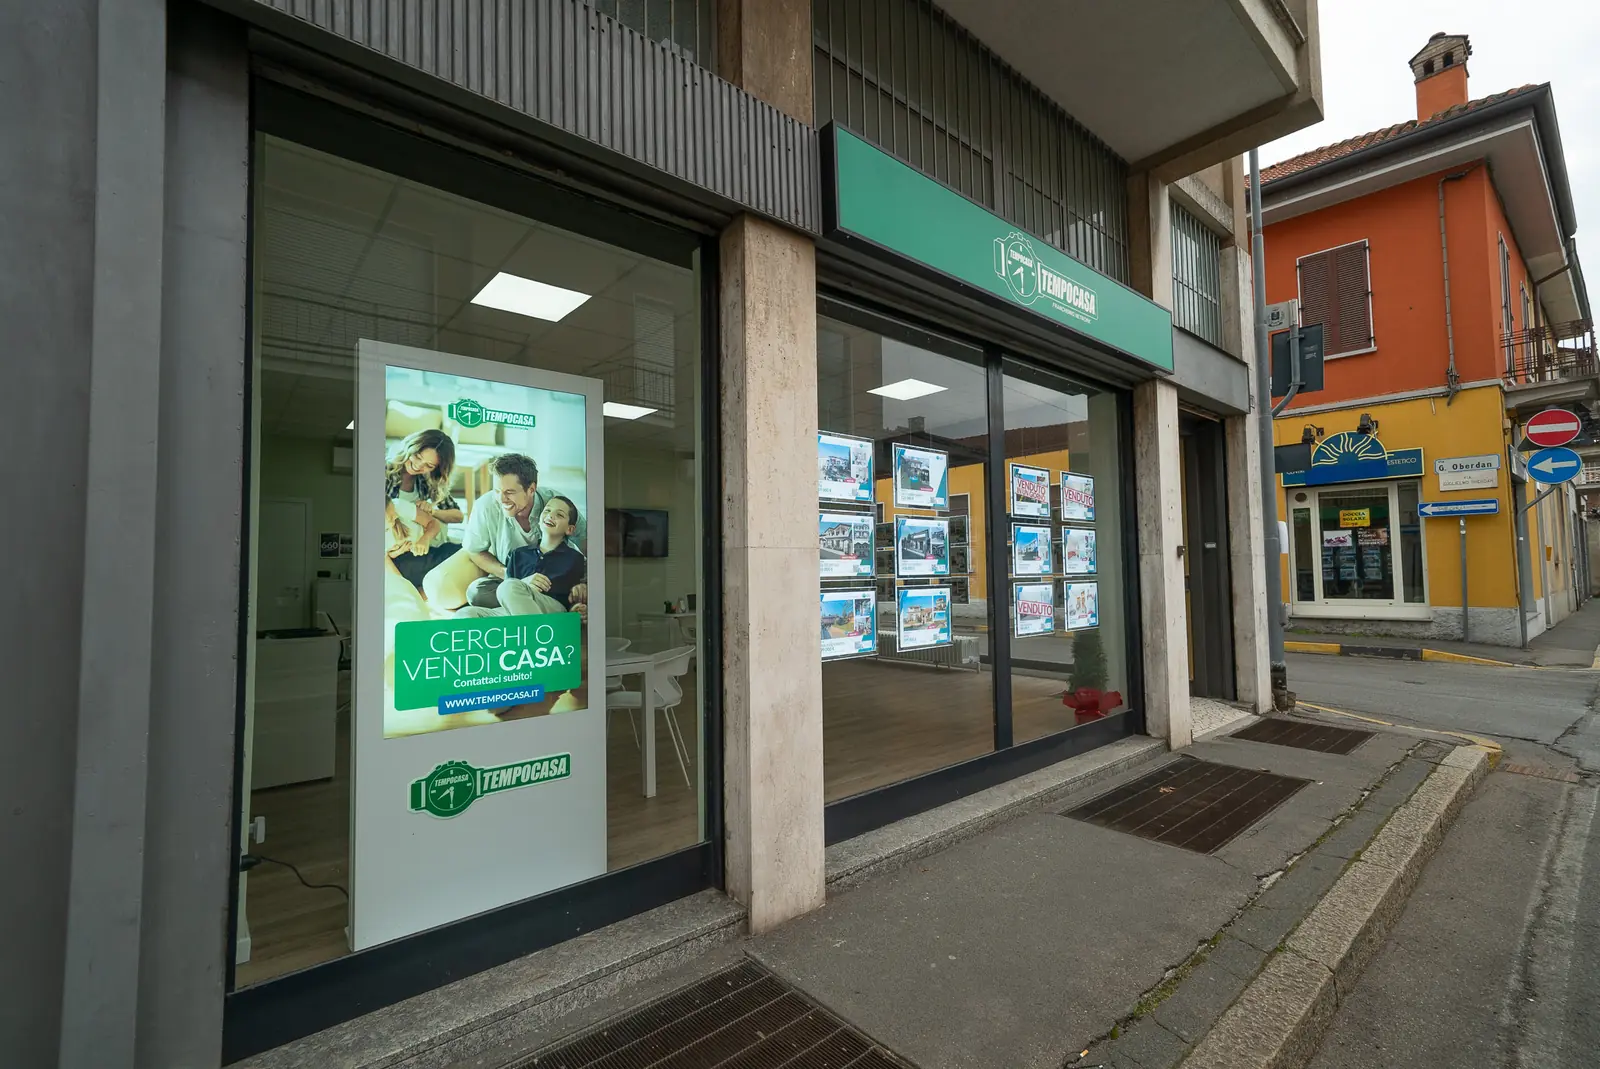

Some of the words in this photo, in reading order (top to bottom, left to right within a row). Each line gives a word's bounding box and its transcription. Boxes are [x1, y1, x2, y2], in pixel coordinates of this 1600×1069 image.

[1042, 268, 1096, 315] TEMPOCASA
[486, 410, 534, 426] TEMPOCASA
[1386, 457, 1417, 466] ESTETICO
[1438, 464, 1447, 472] G.
[1452, 461, 1492, 471] Oberdan
[1017, 479, 1046, 495] VENDUTO
[1063, 487, 1094, 506] VENDUTO
[1017, 601, 1053, 616] VENDUTO
[430, 626, 527, 654] CERCHI
[535, 624, 554, 645] O
[402, 652, 490, 681] VENDI
[499, 645, 575, 671] CASA?
[453, 674, 501, 688] Contattaci
[503, 671, 533, 683] subito!
[445, 689, 540, 709] WWW.TEMPOCASA.IT
[434, 773, 469, 788] TEMPOCASA
[482, 757, 567, 791] TEMPOCASA
